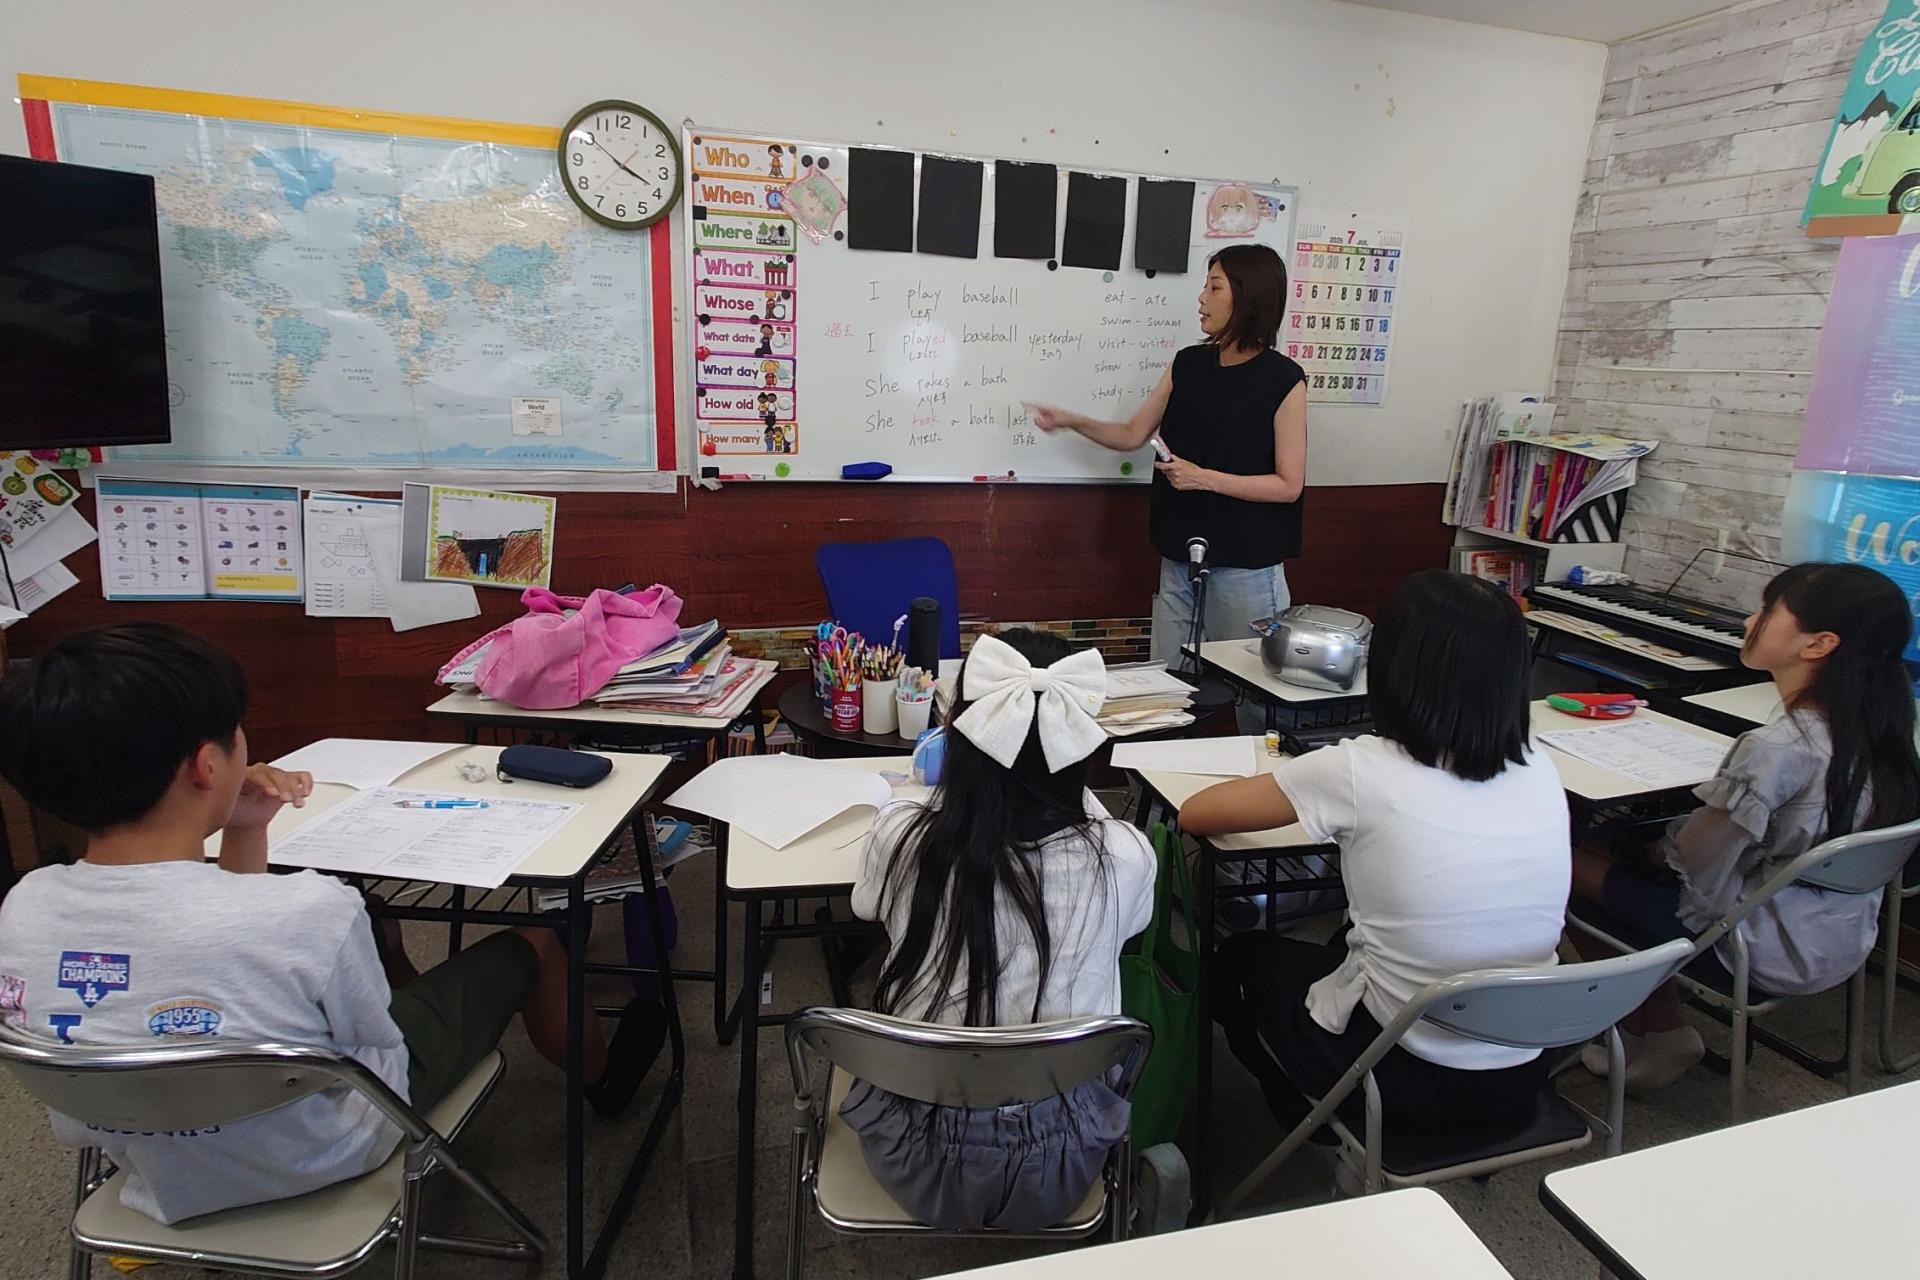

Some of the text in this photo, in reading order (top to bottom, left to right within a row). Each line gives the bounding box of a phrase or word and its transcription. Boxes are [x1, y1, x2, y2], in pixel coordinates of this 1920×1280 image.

[596, 117, 608, 132] 11
[616, 114, 631, 130] 12
[655, 144, 666, 158] 2
[704, 146, 750, 168] Who
[572, 153, 584, 167] 9
[658, 167, 669, 180] 3
[578, 176, 589, 190] 8
[594, 194, 605, 208] 7
[652, 188, 662, 200] 4
[701, 184, 755, 206] When
[615, 204, 626, 217] 6
[637, 202, 648, 214] 5
[701, 223, 753, 240] Where
[1347, 230, 1356, 244] 7
[704, 257, 754, 277] What
[1312, 253, 1325, 269] 29
[1327, 254, 1339, 270] 30
[1345, 257, 1351, 270] 1
[1358, 257, 1366, 271] 2
[1373, 258, 1380, 273] 3
[1388, 259, 1394, 273] 4
[869, 281, 1018, 312] I play baseball
[1104, 290, 1125, 304] eat
[1145, 294, 1168, 306] ate
[1296, 284, 1393, 304] 5 6 7 8 9 10 11
[704, 294, 755, 311] Whose
[1100, 316, 1132, 326] swim
[1147, 317, 1181, 328] swam
[1291, 314, 1389, 333] 12 13 14 15 16 17 18
[703, 331, 756, 343] What date
[866, 332, 878, 353] I
[903, 328, 948, 354] played
[962, 324, 1017, 344] baseball
[1099, 338, 1126, 350] visit
[1139, 334, 1176, 349] visited
[1288, 344, 1385, 362] 19 20 21 22 23 24 25
[703, 364, 759, 379] What day
[866, 373, 900, 398] She
[916, 371, 950, 391] takes
[981, 365, 1008, 387] bath
[1312, 375, 1325, 388] 28
[1327, 375, 1340, 389] 29
[1341, 376, 1354, 389] 30
[1356, 377, 1368, 390] 31
[705, 398, 754, 410] How old
[866, 410, 895, 433] She
[911, 407, 939, 427] took
[969, 404, 995, 426] bath
[706, 434, 761, 446] How many
[63, 961, 128, 970] WORLD SERIES
[61, 968, 128, 983] CHAMPIONS
[167, 1007, 201, 1025] 1955
